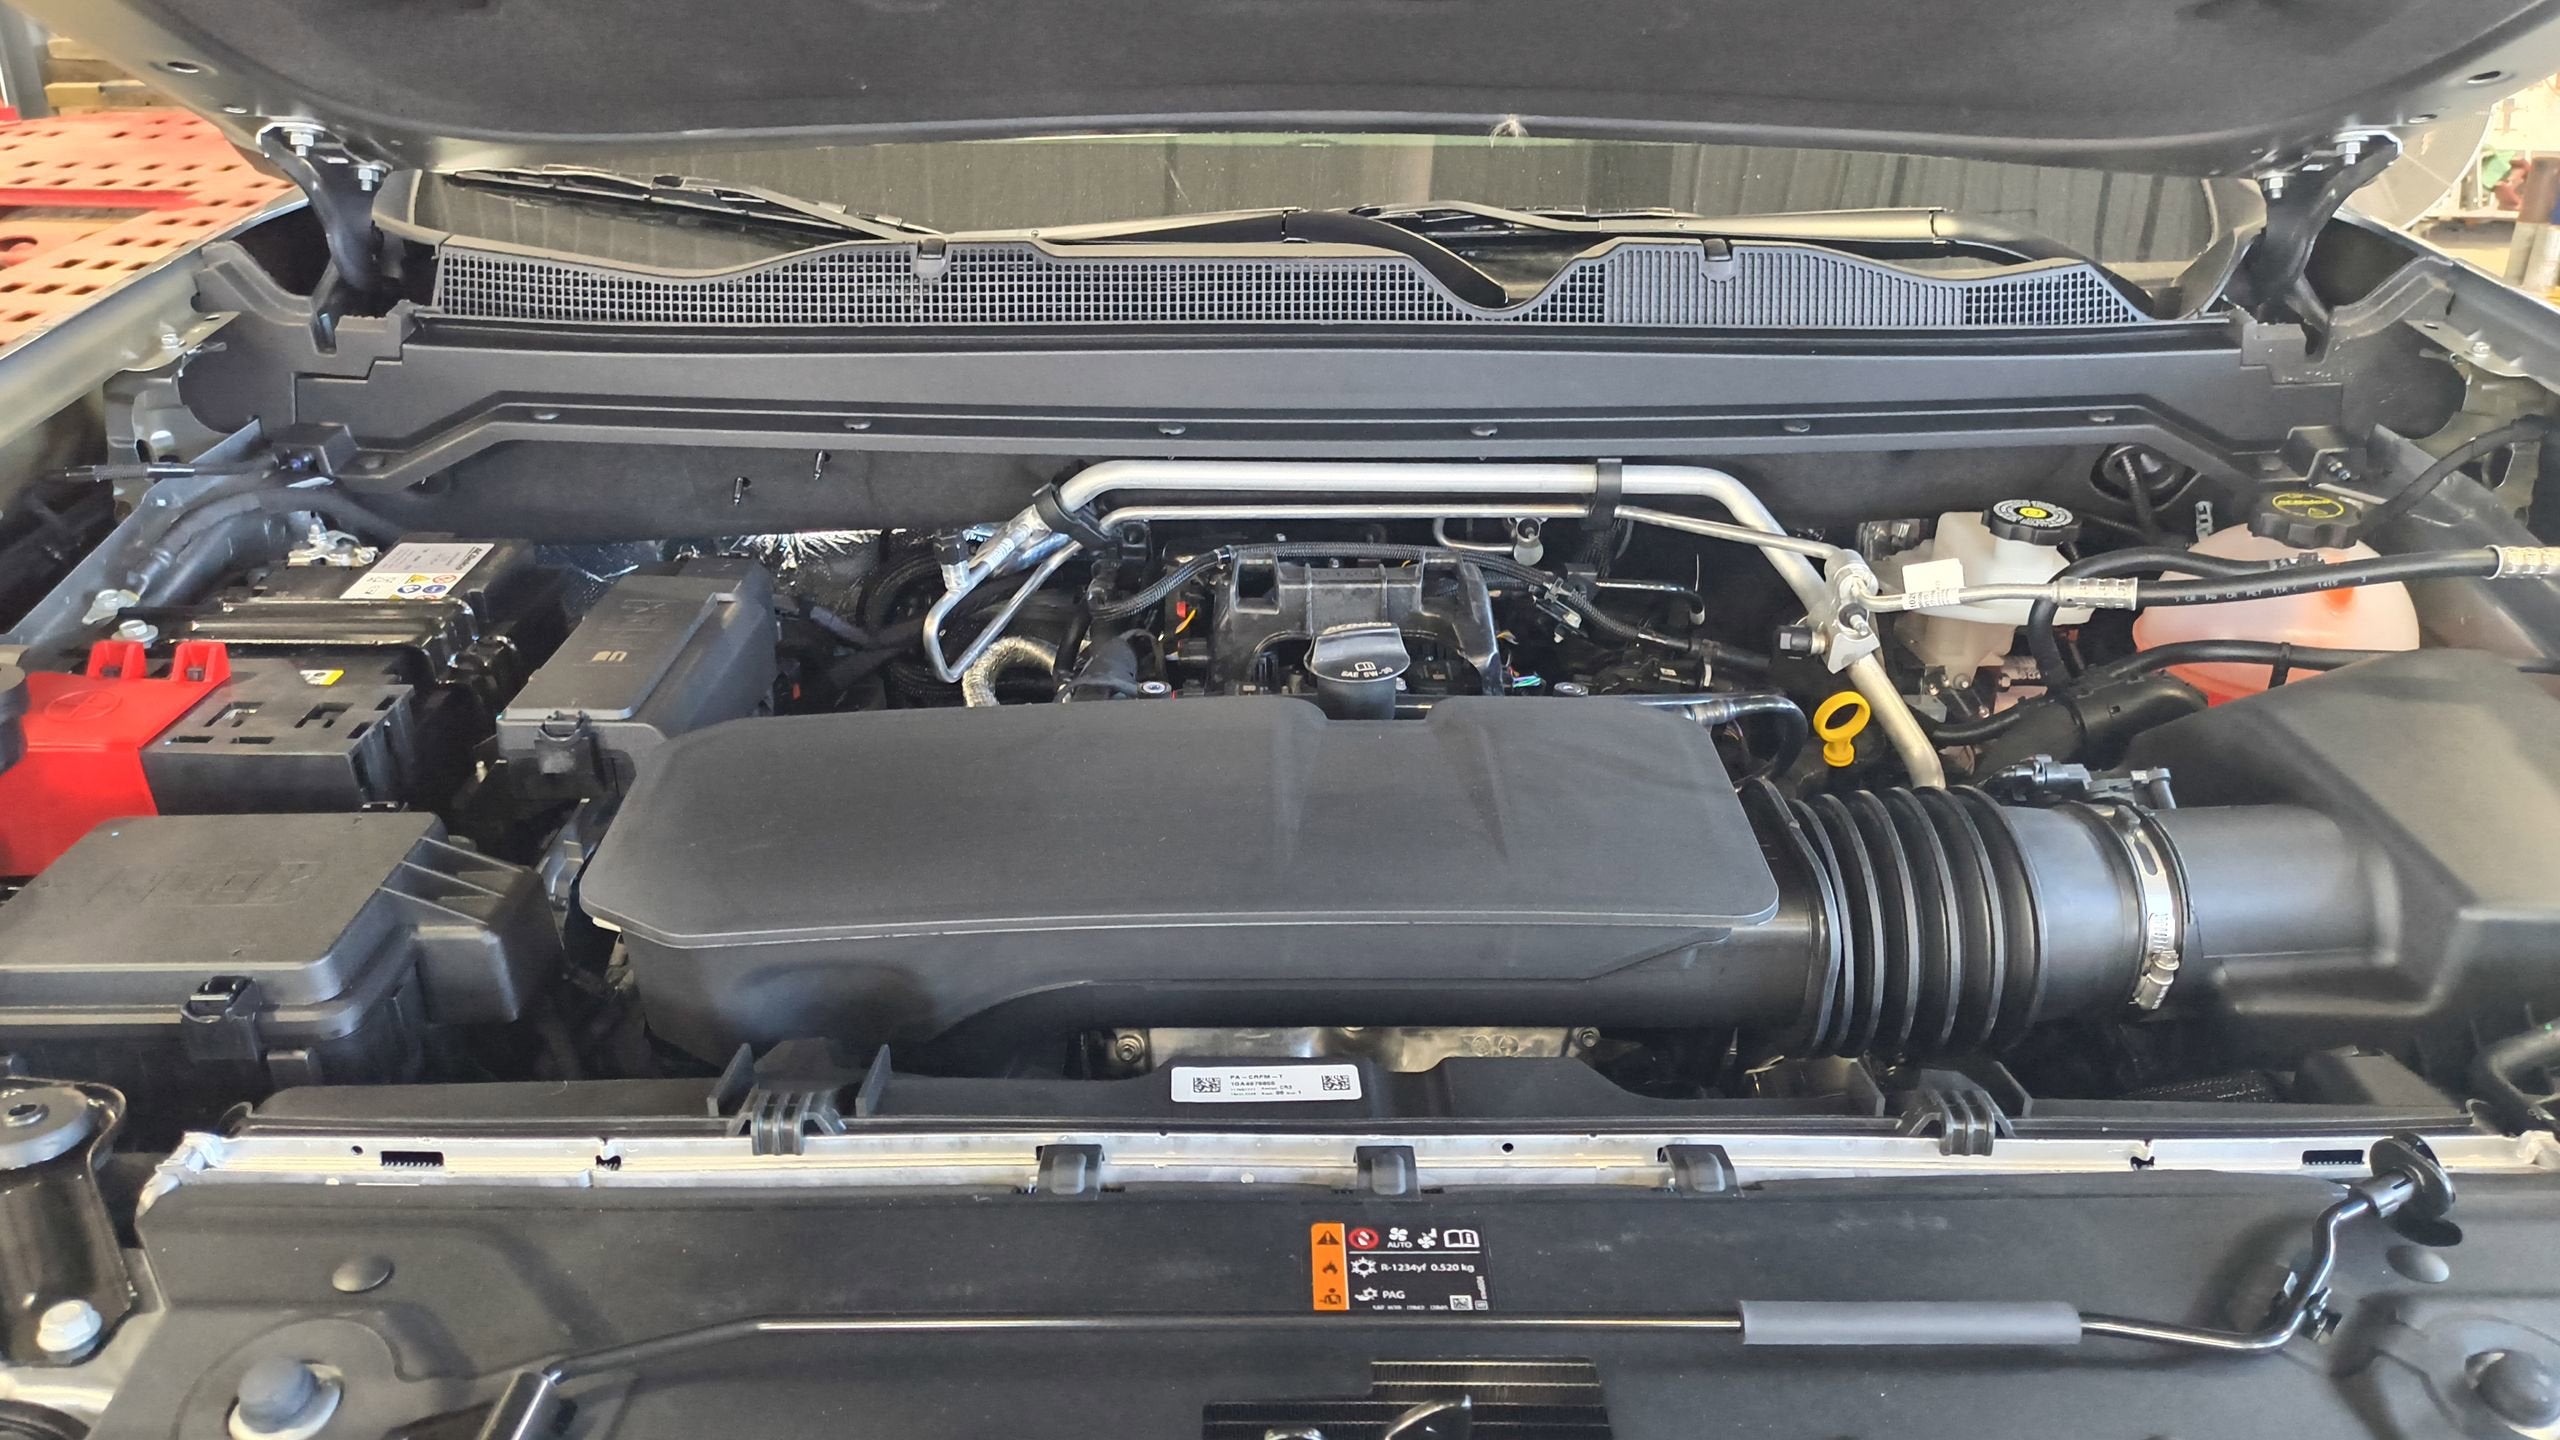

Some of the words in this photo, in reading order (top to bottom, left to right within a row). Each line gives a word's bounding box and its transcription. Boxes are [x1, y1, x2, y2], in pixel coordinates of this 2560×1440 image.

[1387, 1241, 1413, 1249] AUTO
[1380, 1263, 1427, 1274] R-1234yf
[1430, 1263, 1460, 1272] 0.520
[1461, 1263, 1476, 1273] kg
[1382, 1290, 1406, 1300] PAG
